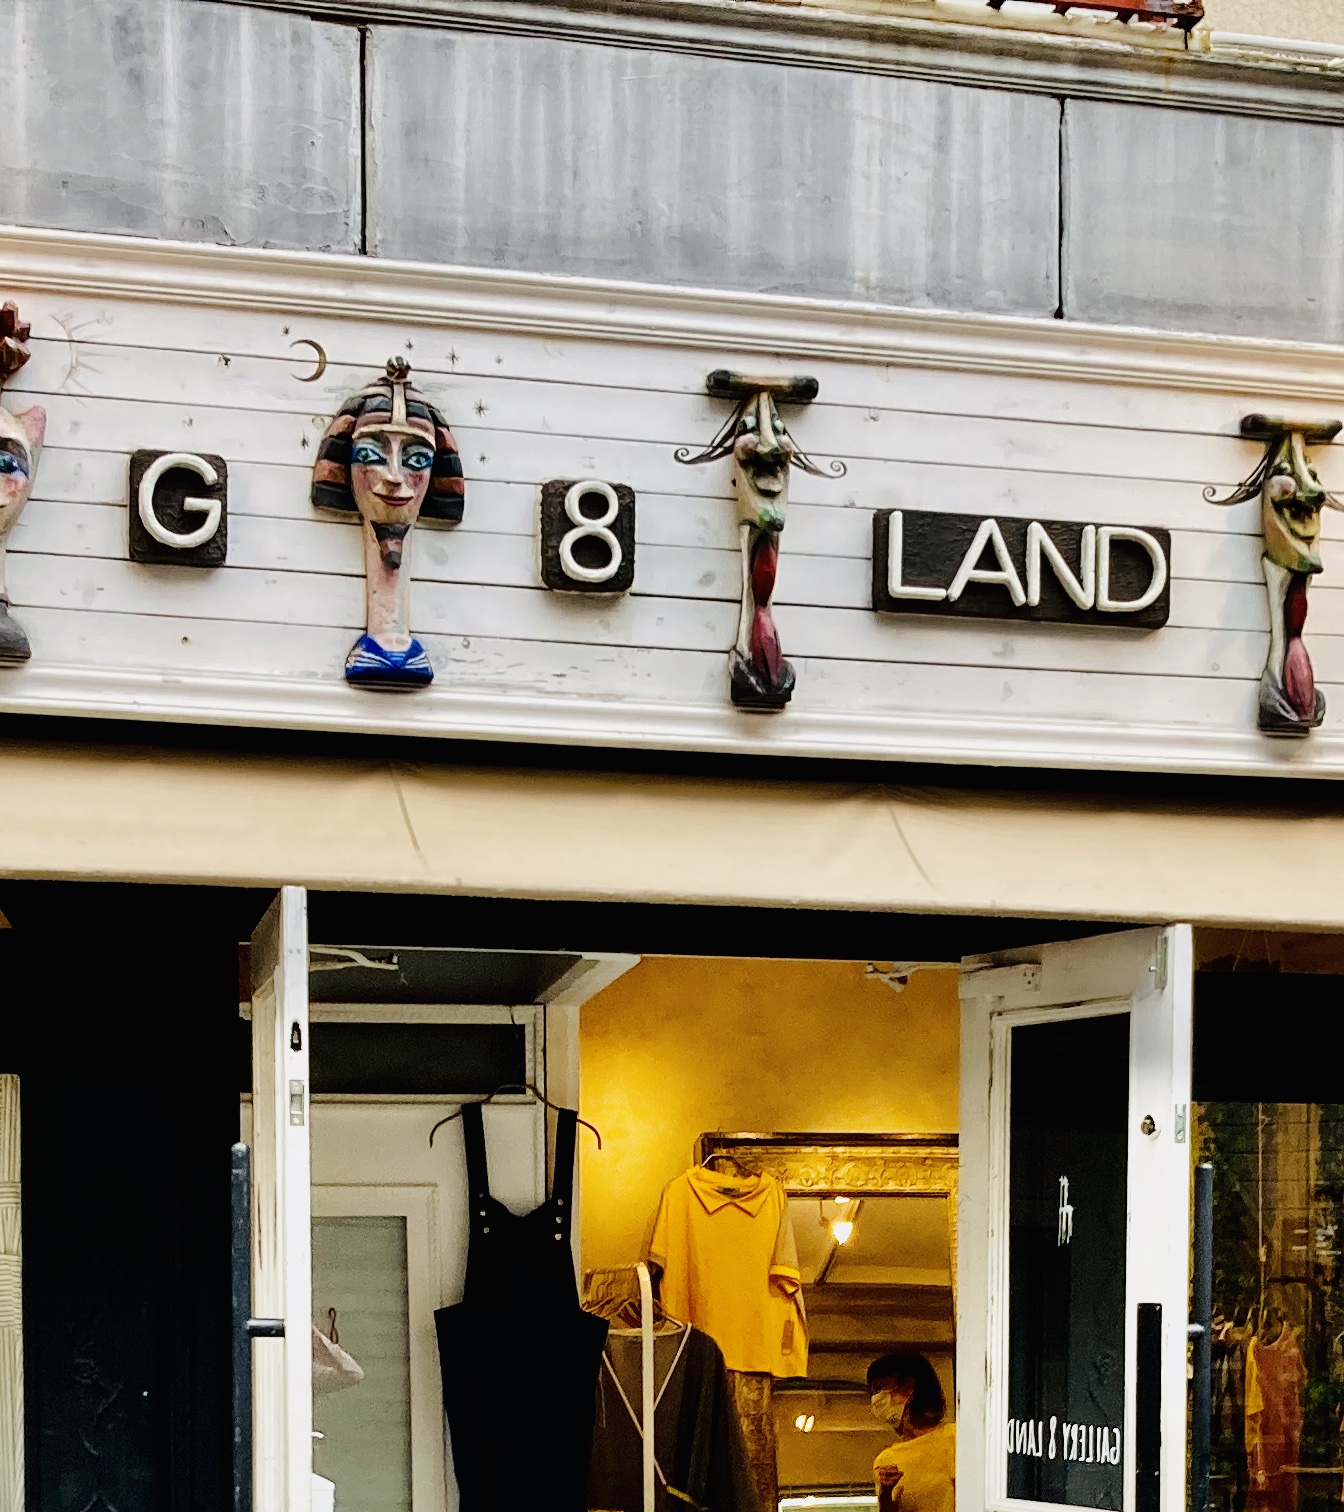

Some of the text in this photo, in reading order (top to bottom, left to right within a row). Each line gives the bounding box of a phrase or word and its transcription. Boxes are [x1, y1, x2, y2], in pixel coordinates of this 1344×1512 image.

[139, 453, 1167, 612] G 8 LAND
